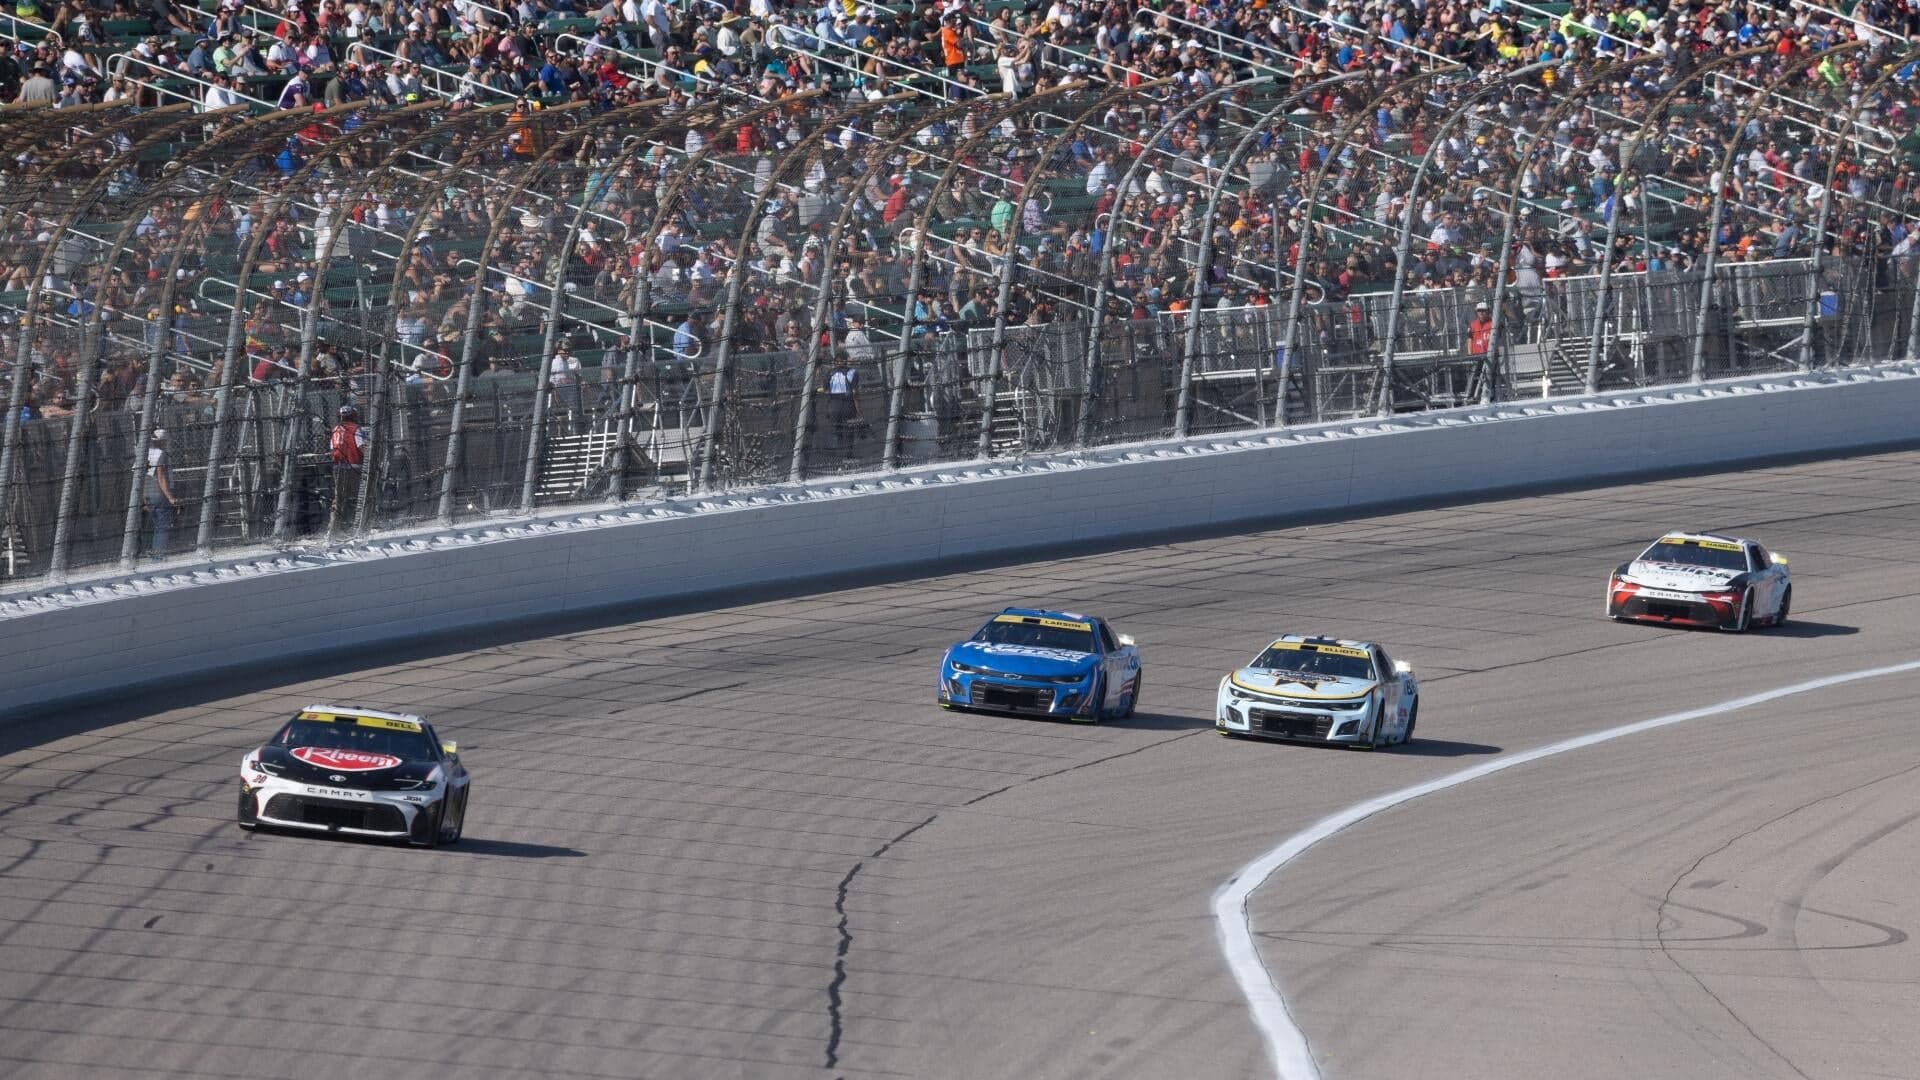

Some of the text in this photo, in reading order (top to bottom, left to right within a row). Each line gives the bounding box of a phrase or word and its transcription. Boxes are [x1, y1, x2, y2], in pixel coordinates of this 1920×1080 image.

[1044, 620, 1081, 628] LARSON
[386, 721, 414, 730] BELL
[303, 747, 393, 767] Rheem
[307, 786, 366, 798] CAMRY
